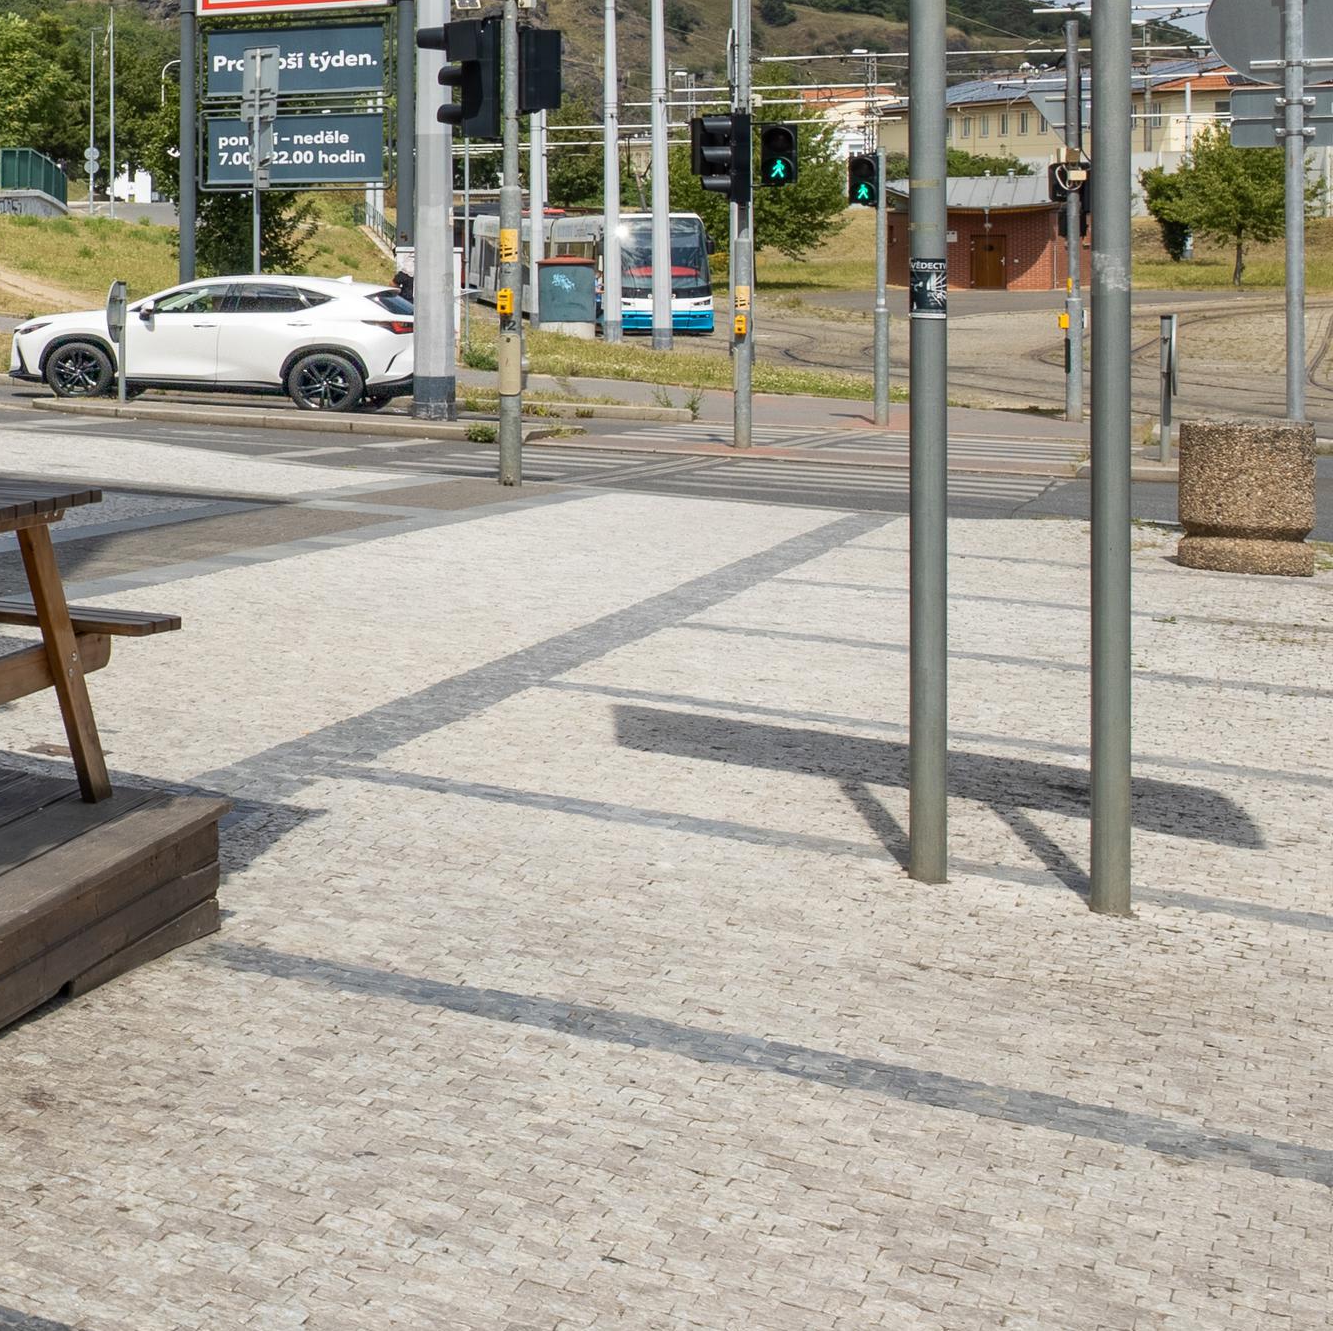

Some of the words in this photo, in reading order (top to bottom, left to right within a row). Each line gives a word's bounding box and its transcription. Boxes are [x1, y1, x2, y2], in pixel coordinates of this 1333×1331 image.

[309, 50, 378, 72] týden.
[218, 132, 279, 150] poní
[293, 130, 350, 145] neděle
[272, 150, 314, 165] 22.00
[318, 149, 366, 164] hodin
